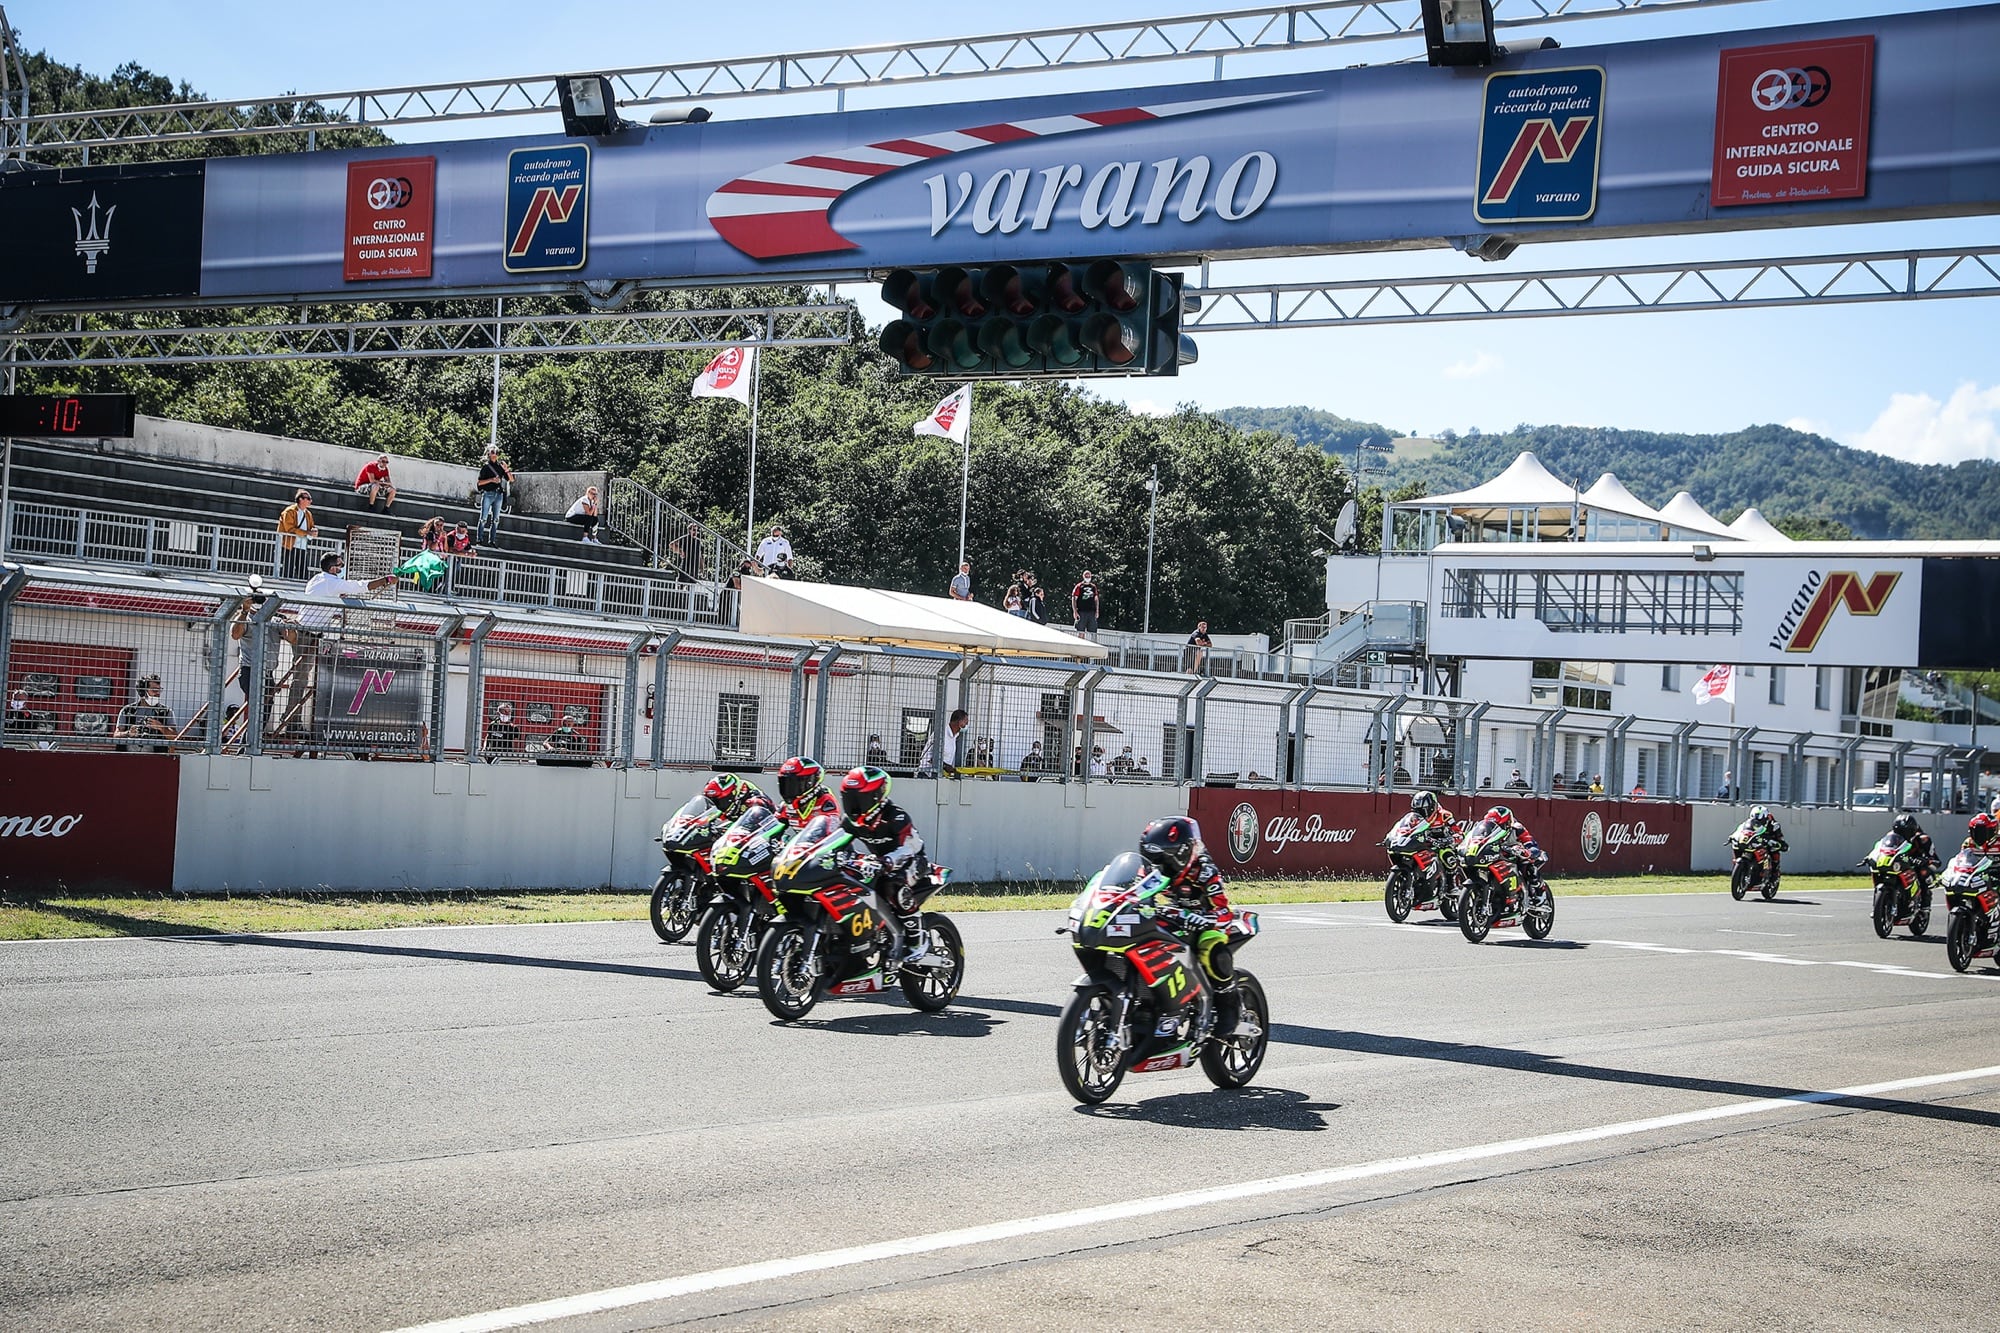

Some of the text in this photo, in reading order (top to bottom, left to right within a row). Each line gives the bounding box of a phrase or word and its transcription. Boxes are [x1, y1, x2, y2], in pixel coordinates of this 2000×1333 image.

[1508, 84, 1578, 98] autodromo
[1494, 97, 1592, 114] riccardo paletti
[1762, 122, 1819, 138] CENTRO
[1726, 138, 1853, 159] INTERNAZIONALE
[524, 159, 572, 171] autodromo
[1736, 159, 1840, 178] GUIDA SICURA
[514, 169, 580, 183] riccardo paletti
[923, 150, 1278, 238] varano
[1536, 192, 1580, 203] varano
[373, 219, 406, 230] CENTRO
[353, 232, 425, 245] INTERNAZIONALE
[359, 247, 418, 260] GUIDA SICURA
[545, 246, 576, 255] varano
[1769, 570, 1821, 651] varano
[364, 650, 399, 661] varano
[323, 729, 416, 742] www.varano.it
[1265, 814, 1356, 854] Alfa Romeo
[1606, 823, 1633, 854] Alfa
[1632, 821, 1670, 845] Romeo
[852, 908, 873, 936] 64
[1167, 966, 1187, 999] 15
